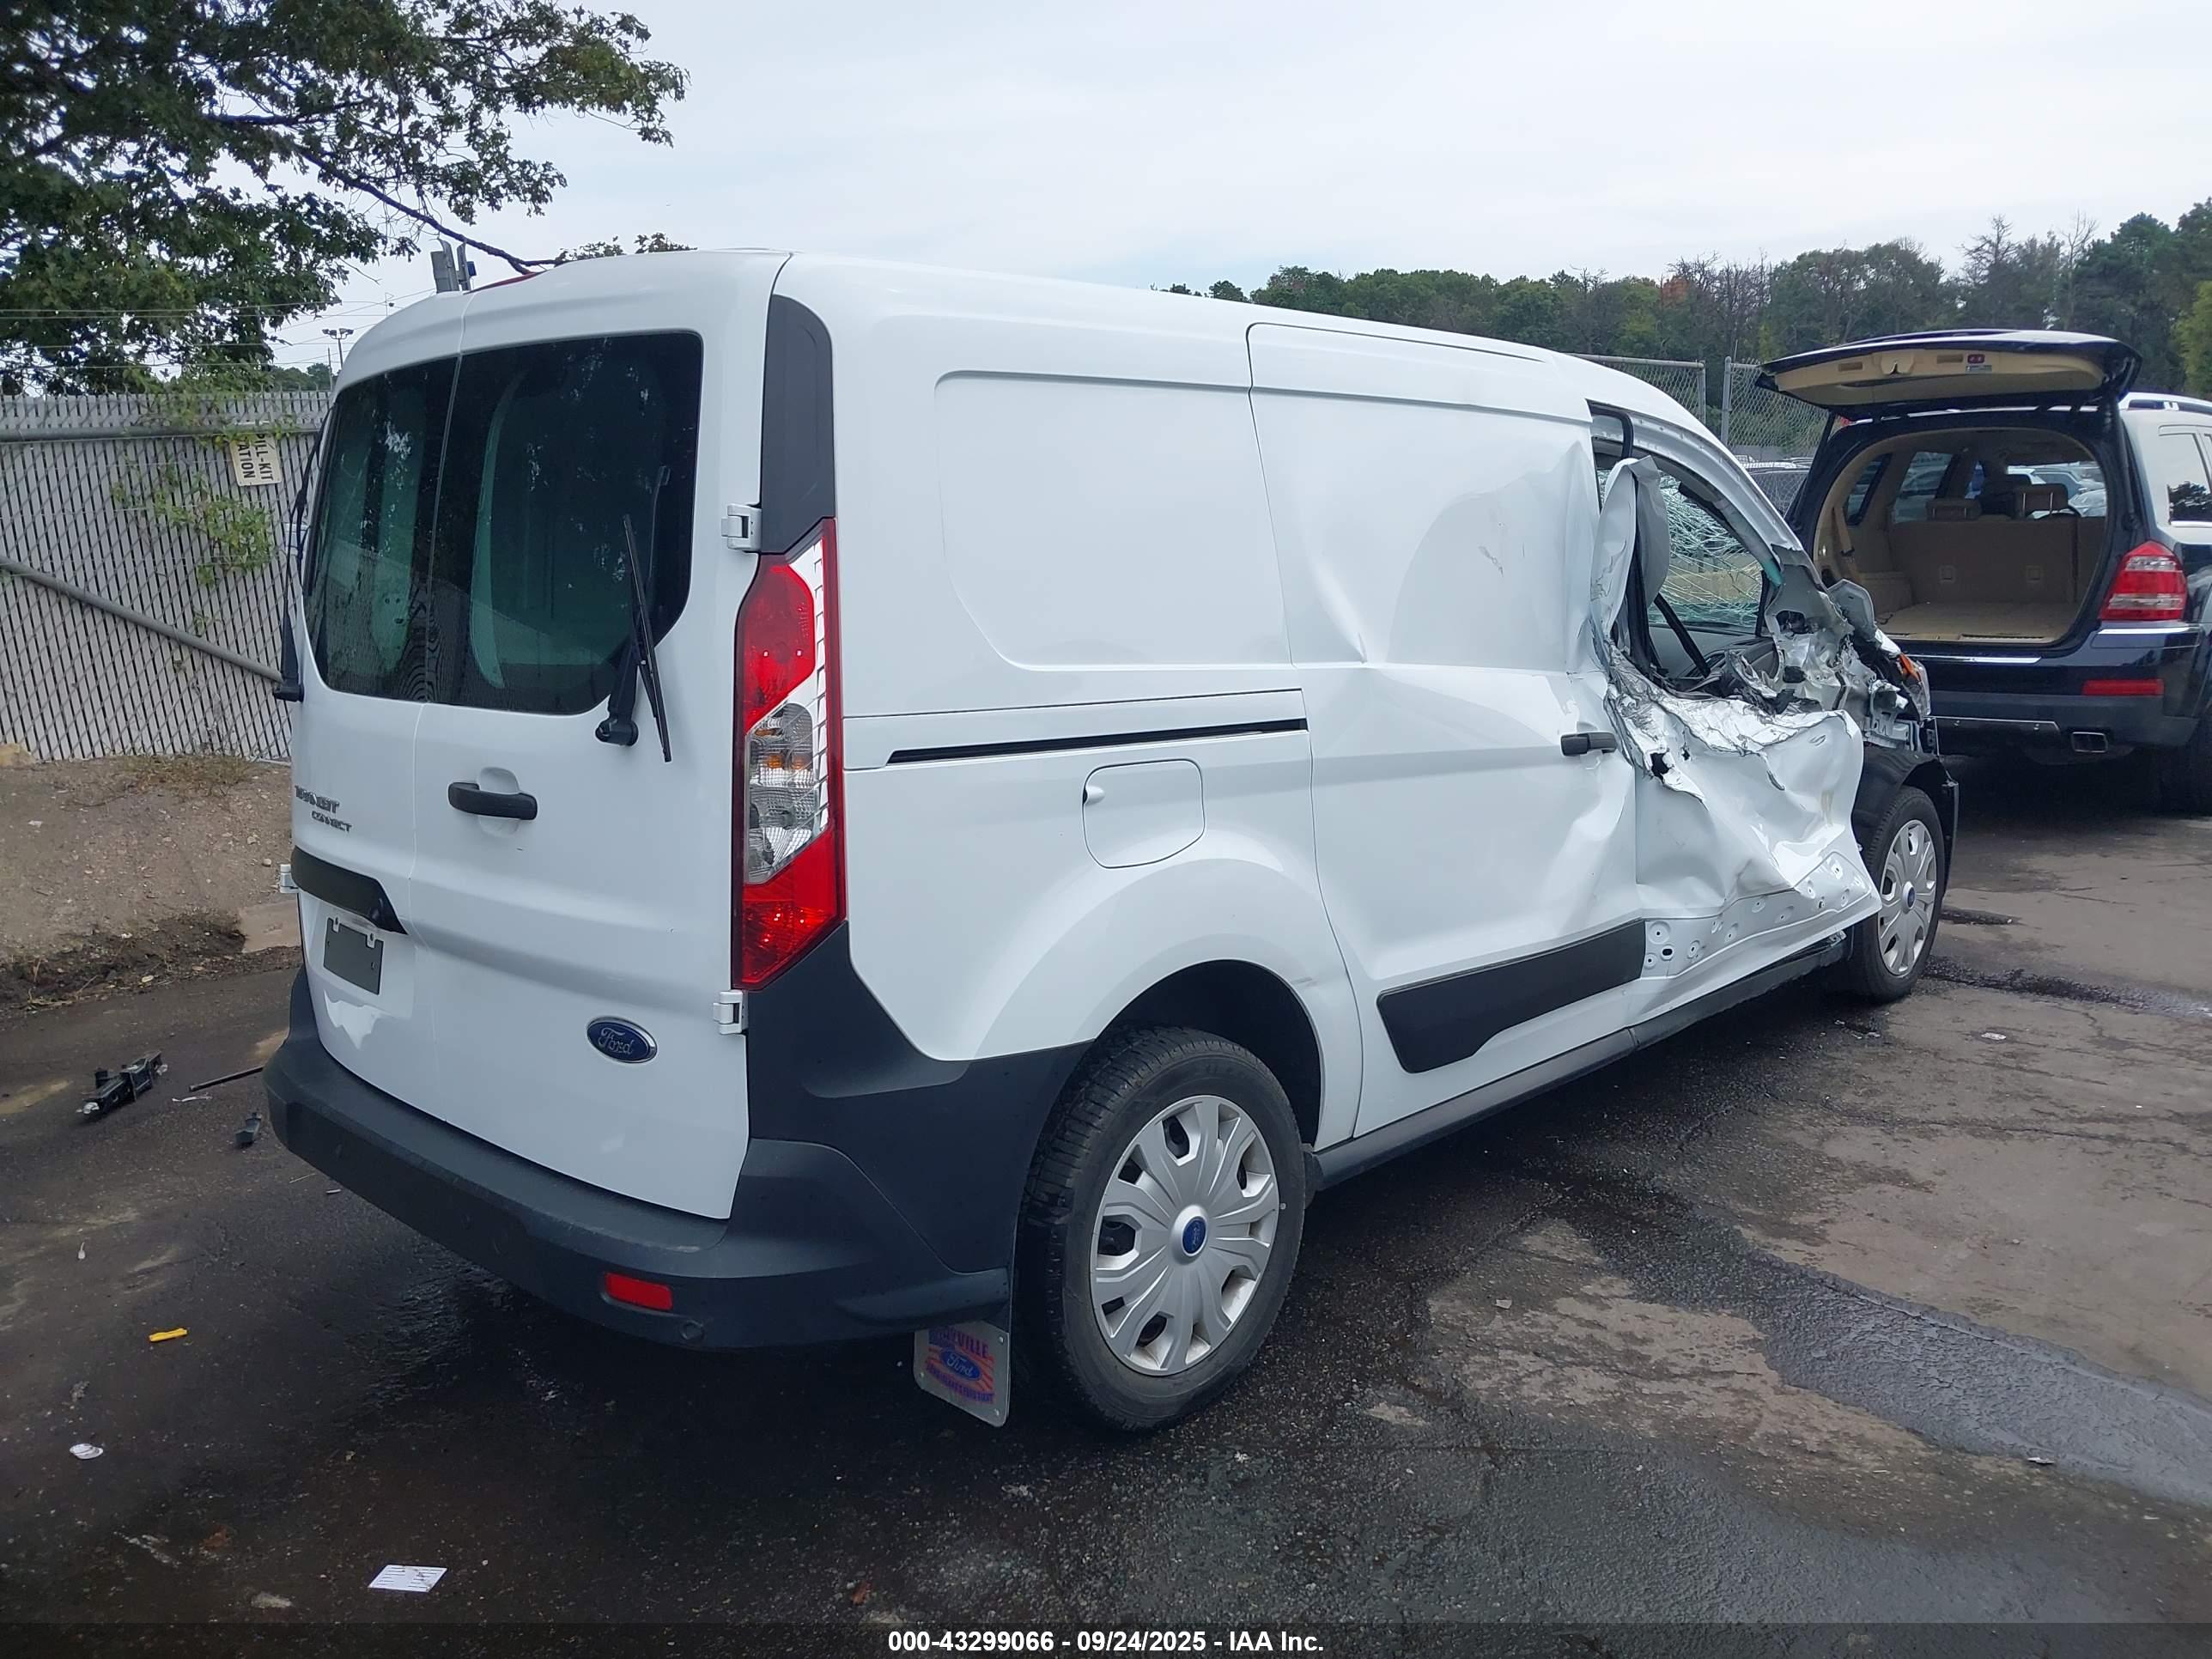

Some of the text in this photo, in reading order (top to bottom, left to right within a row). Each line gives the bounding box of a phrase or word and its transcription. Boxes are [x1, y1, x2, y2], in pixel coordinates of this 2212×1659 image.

[237, 441, 256, 479] ATION
[254, 433, 274, 481] PILL-KIT
[598, 1027, 635, 1055] Ford
